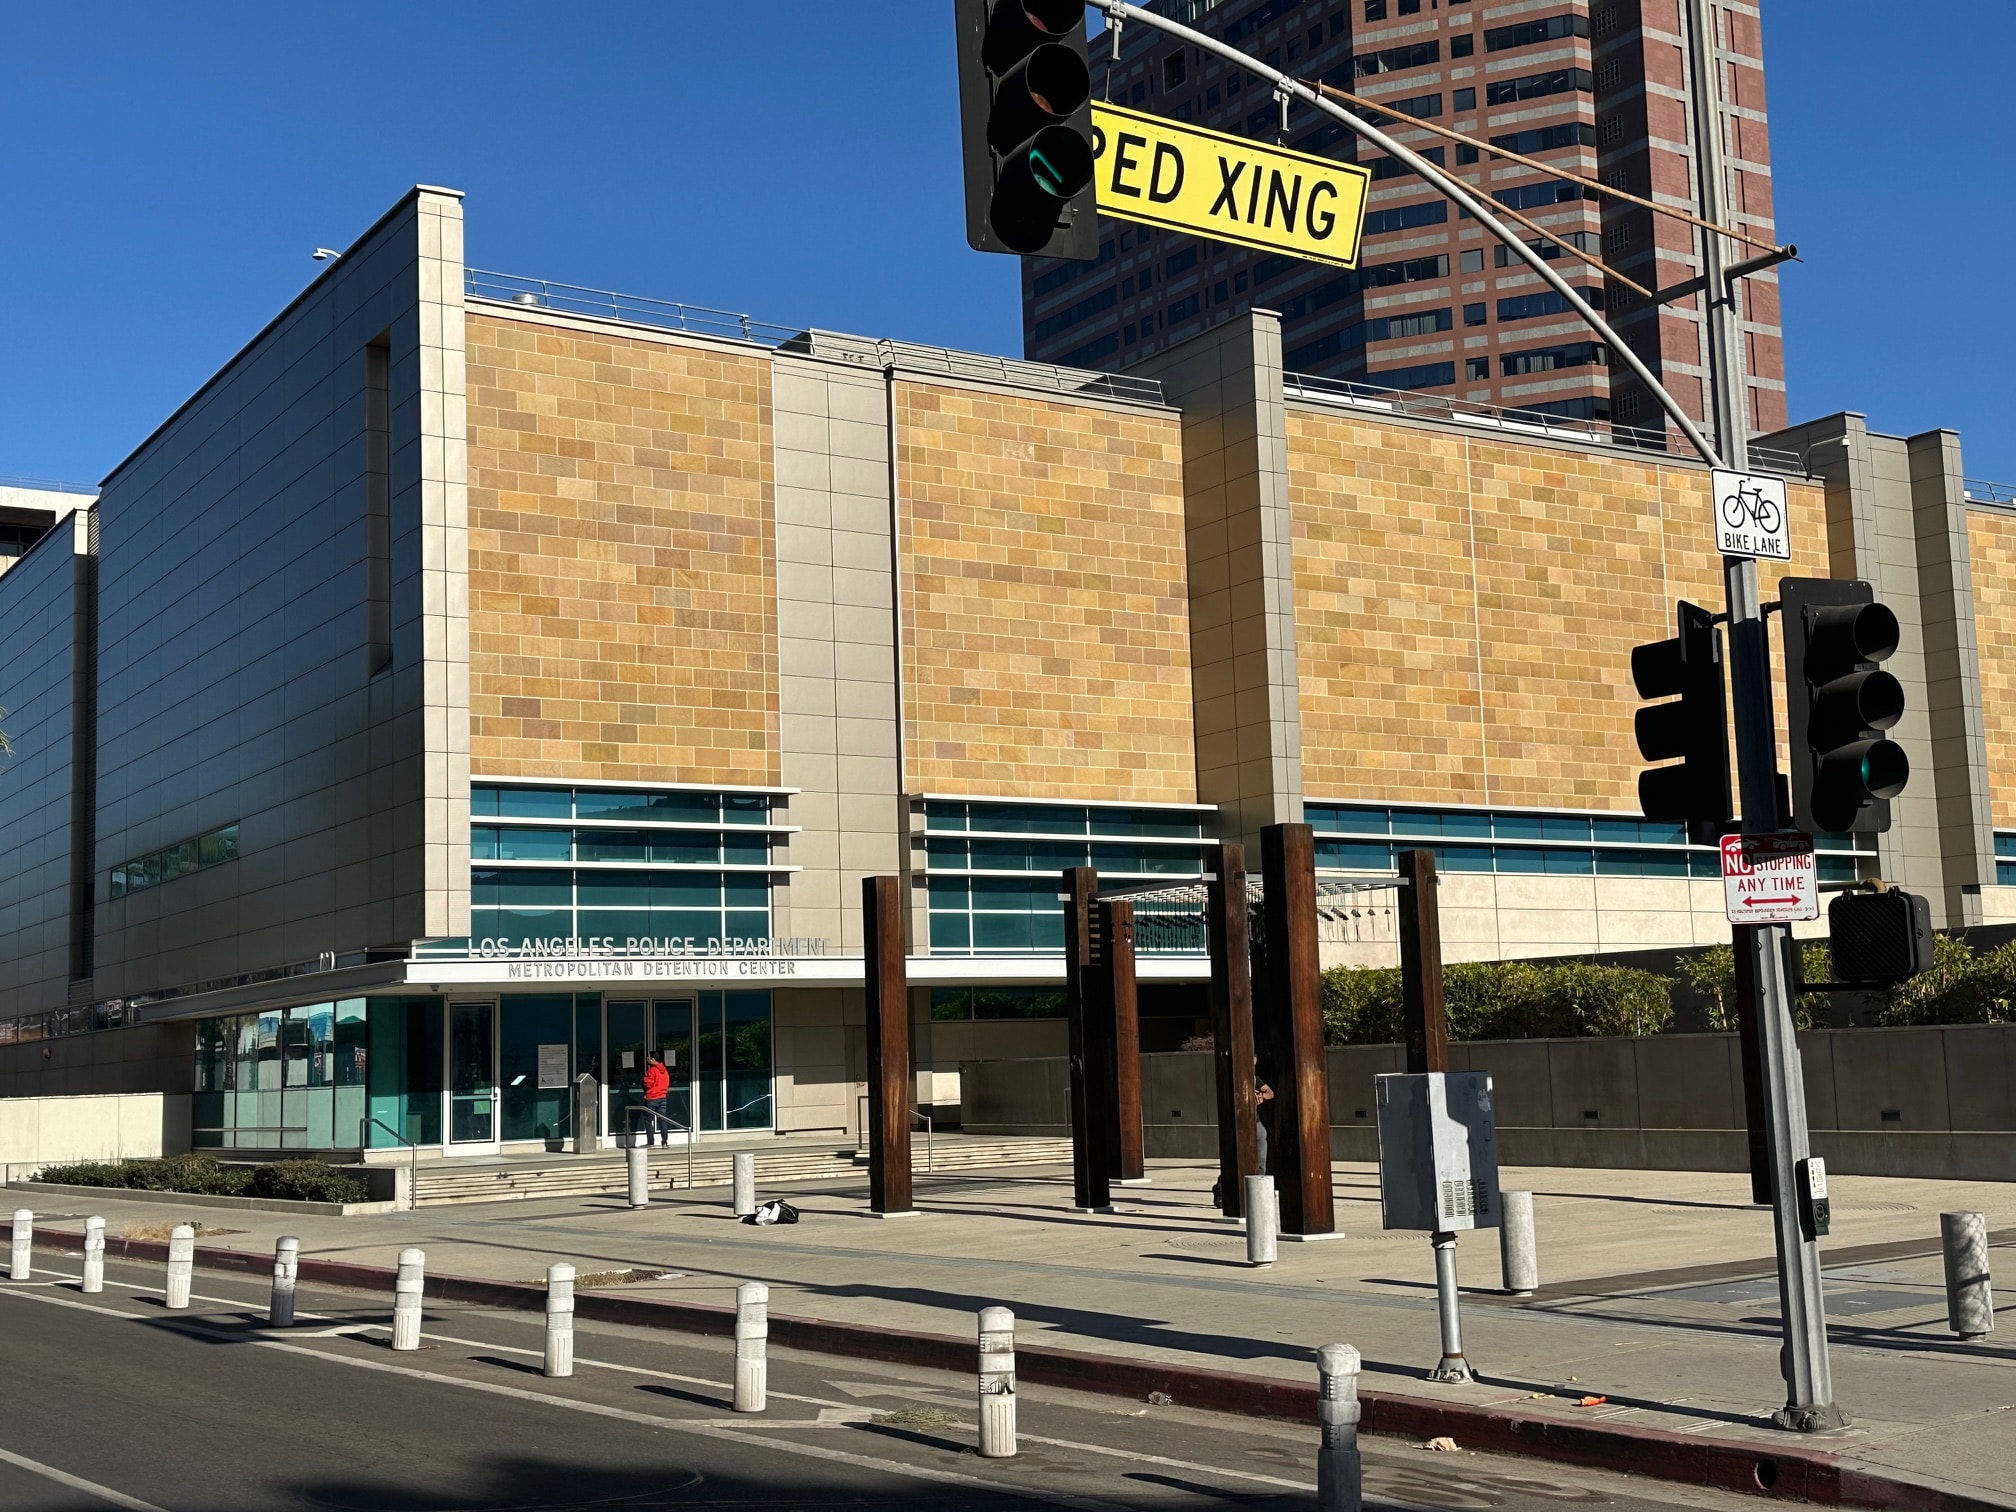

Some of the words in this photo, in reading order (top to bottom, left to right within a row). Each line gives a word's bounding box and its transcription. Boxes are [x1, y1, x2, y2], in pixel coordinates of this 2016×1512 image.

[1208, 155, 1338, 241] XING
[1725, 533, 1749, 550] BIKE
[1754, 536, 1781, 553] LANE
[1725, 853, 1752, 874] NO
[1756, 854, 1811, 872] STOPPING
[1738, 878, 1765, 891] ANY
[1771, 876, 1805, 890] TIME
[467, 937, 510, 958] LOS
[520, 936, 614, 958] ANGELES
[626, 936, 695, 956] POLICE
[707, 936, 829, 956] DEPARTMENT
[508, 962, 633, 978] METROPOLITAN
[643, 961, 729, 976] DETENTION
[739, 961, 796, 975] CENTER
